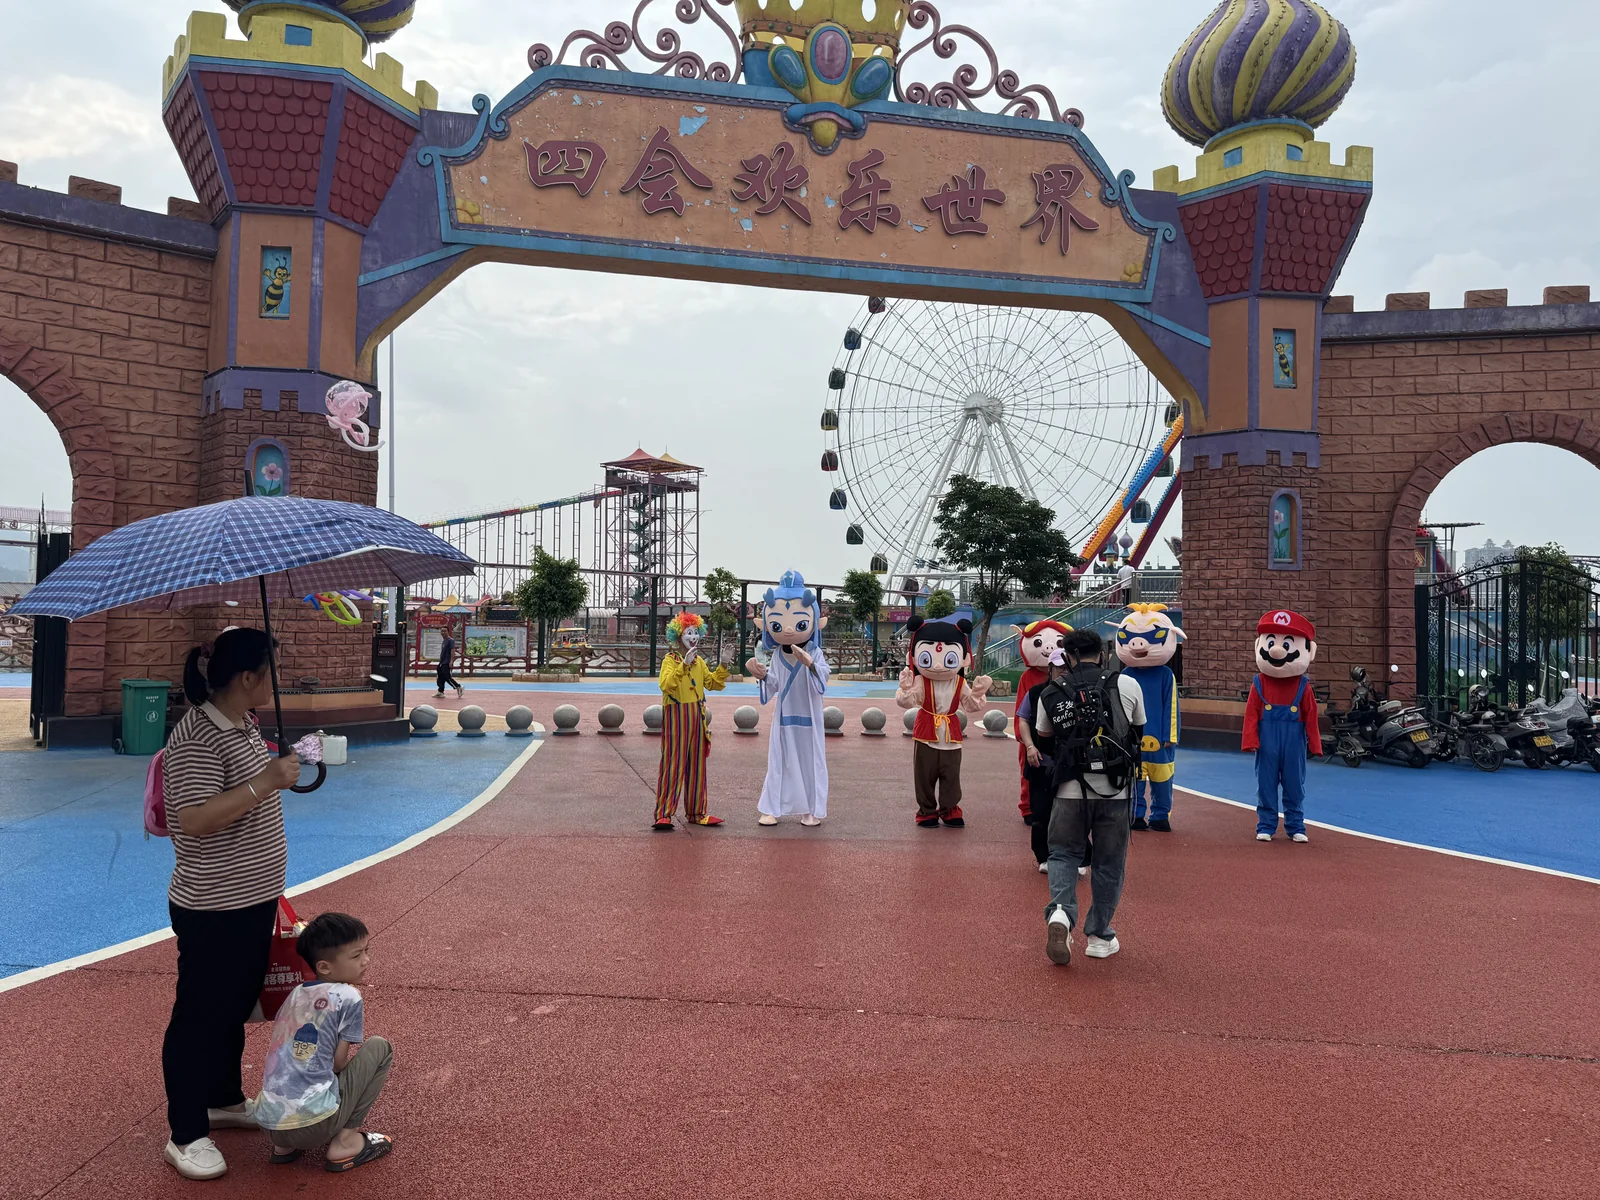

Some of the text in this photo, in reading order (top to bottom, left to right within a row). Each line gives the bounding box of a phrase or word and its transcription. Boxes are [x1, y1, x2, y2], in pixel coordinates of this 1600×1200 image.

[523, 126, 1099, 255] 四会欢乐世界
[1275, 614, 1288, 624] M
